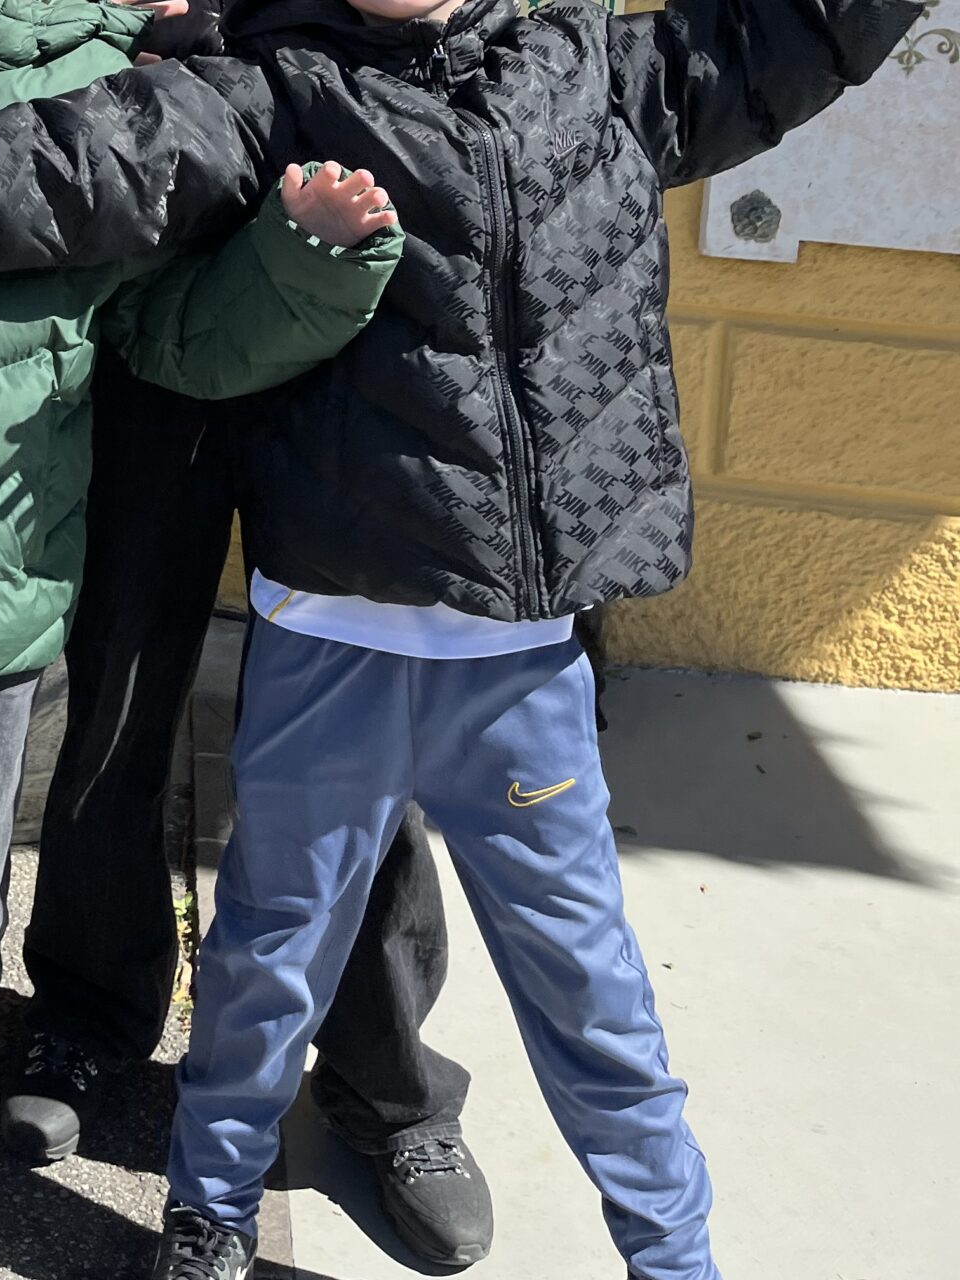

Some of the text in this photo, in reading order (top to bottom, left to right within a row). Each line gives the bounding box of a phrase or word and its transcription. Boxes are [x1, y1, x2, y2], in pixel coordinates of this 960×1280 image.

[514, 175, 549, 205] NIKE
[619, 191, 646, 221] NIKE
[569, 242, 602, 270] NIKE
[541, 265, 579, 295] NIKE
[601, 327, 636, 355] NIKE
[575, 350, 611, 380] NIKE
[546, 374, 586, 405] NIKE
[605, 438, 641, 467] NIKE
[581, 463, 618, 492] NIKE
[472, 497, 512, 529] NIKE
[553, 488, 592, 519] NIKE
[594, 494, 625, 521] NIKE
[564, 520, 598, 549] NIKE
[638, 522, 673, 552] NIKE
[614, 546, 651, 577] NIKE
[652, 553, 682, 583] NIKE
